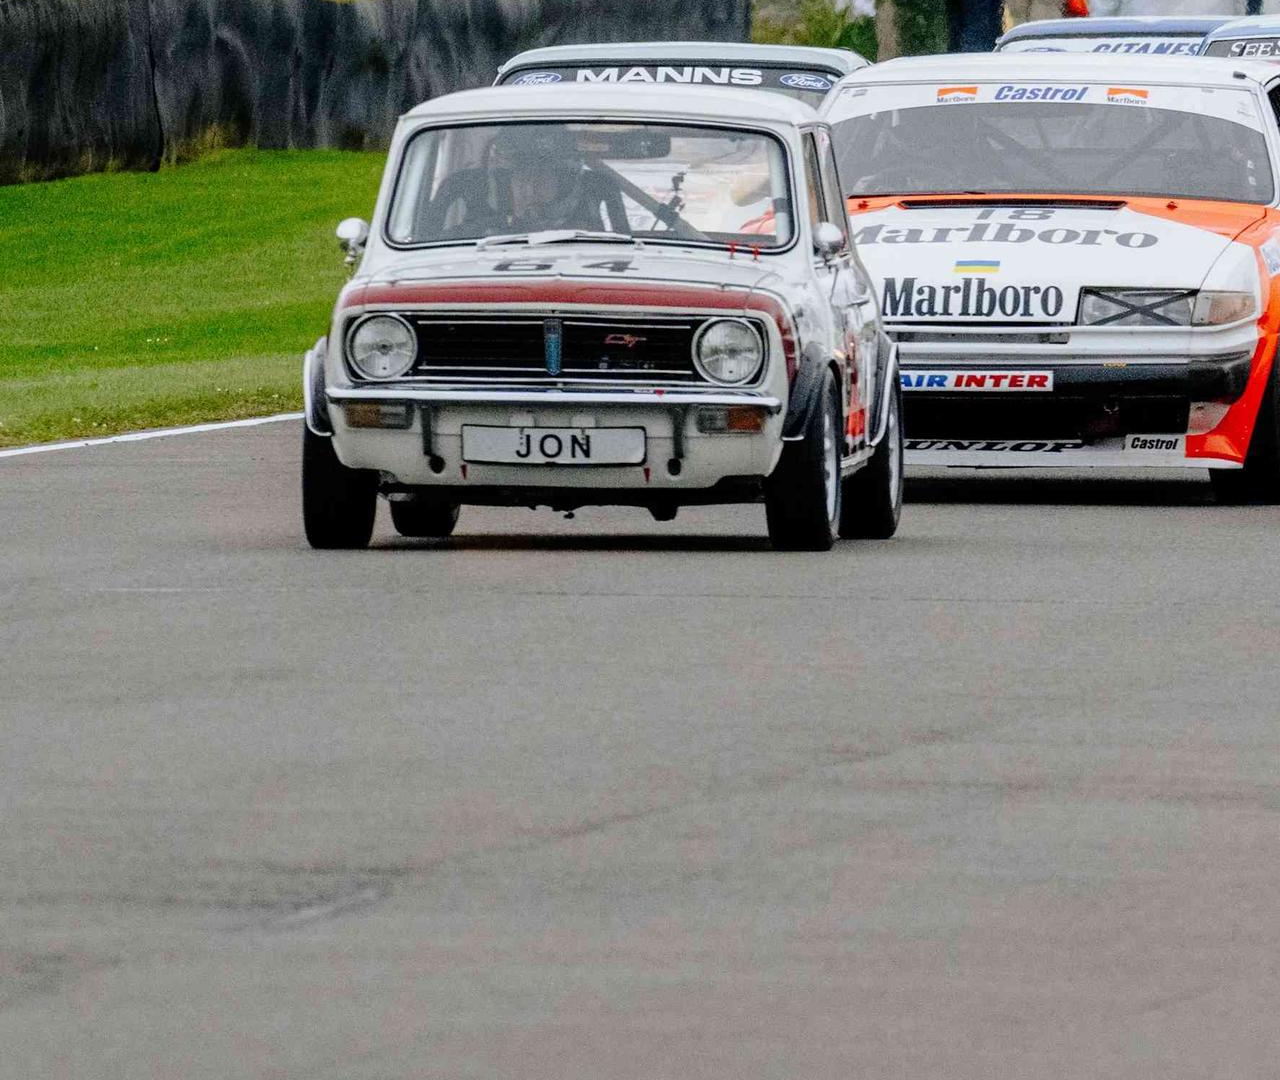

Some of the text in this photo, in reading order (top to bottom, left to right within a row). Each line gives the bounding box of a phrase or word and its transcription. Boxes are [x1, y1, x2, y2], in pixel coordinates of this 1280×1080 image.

[1229, 41, 1271, 58] SEE
[576, 67, 762, 85] MANNS
[785, 75, 824, 89] Ford
[994, 86, 1089, 101] Castrol
[883, 277, 1063, 317] Marlboro
[900, 374, 1048, 388] AIR INTER
[516, 434, 591, 458] JON
[904, 441, 1083, 453] UNLOP
[1131, 437, 1178, 450] Castrol
